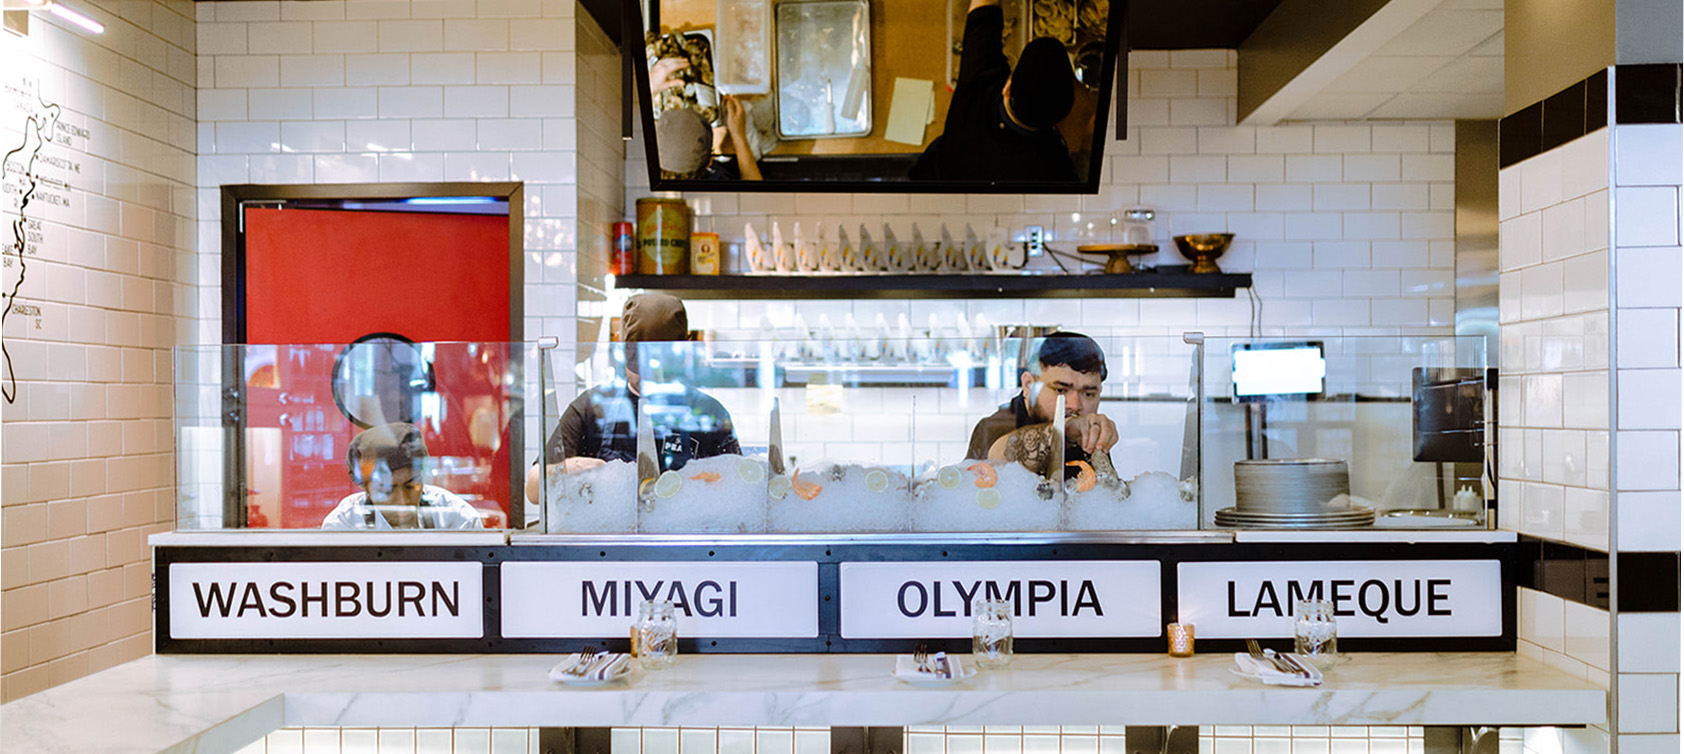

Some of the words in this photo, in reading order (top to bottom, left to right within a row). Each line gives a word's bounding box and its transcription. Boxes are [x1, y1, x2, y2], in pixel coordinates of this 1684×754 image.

[193, 582, 458, 617] WASHBURN
[583, 581, 736, 617] MIYAGI
[898, 581, 1103, 619] OLYMPIA
[1228, 580, 1451, 623] LAMEQUE
